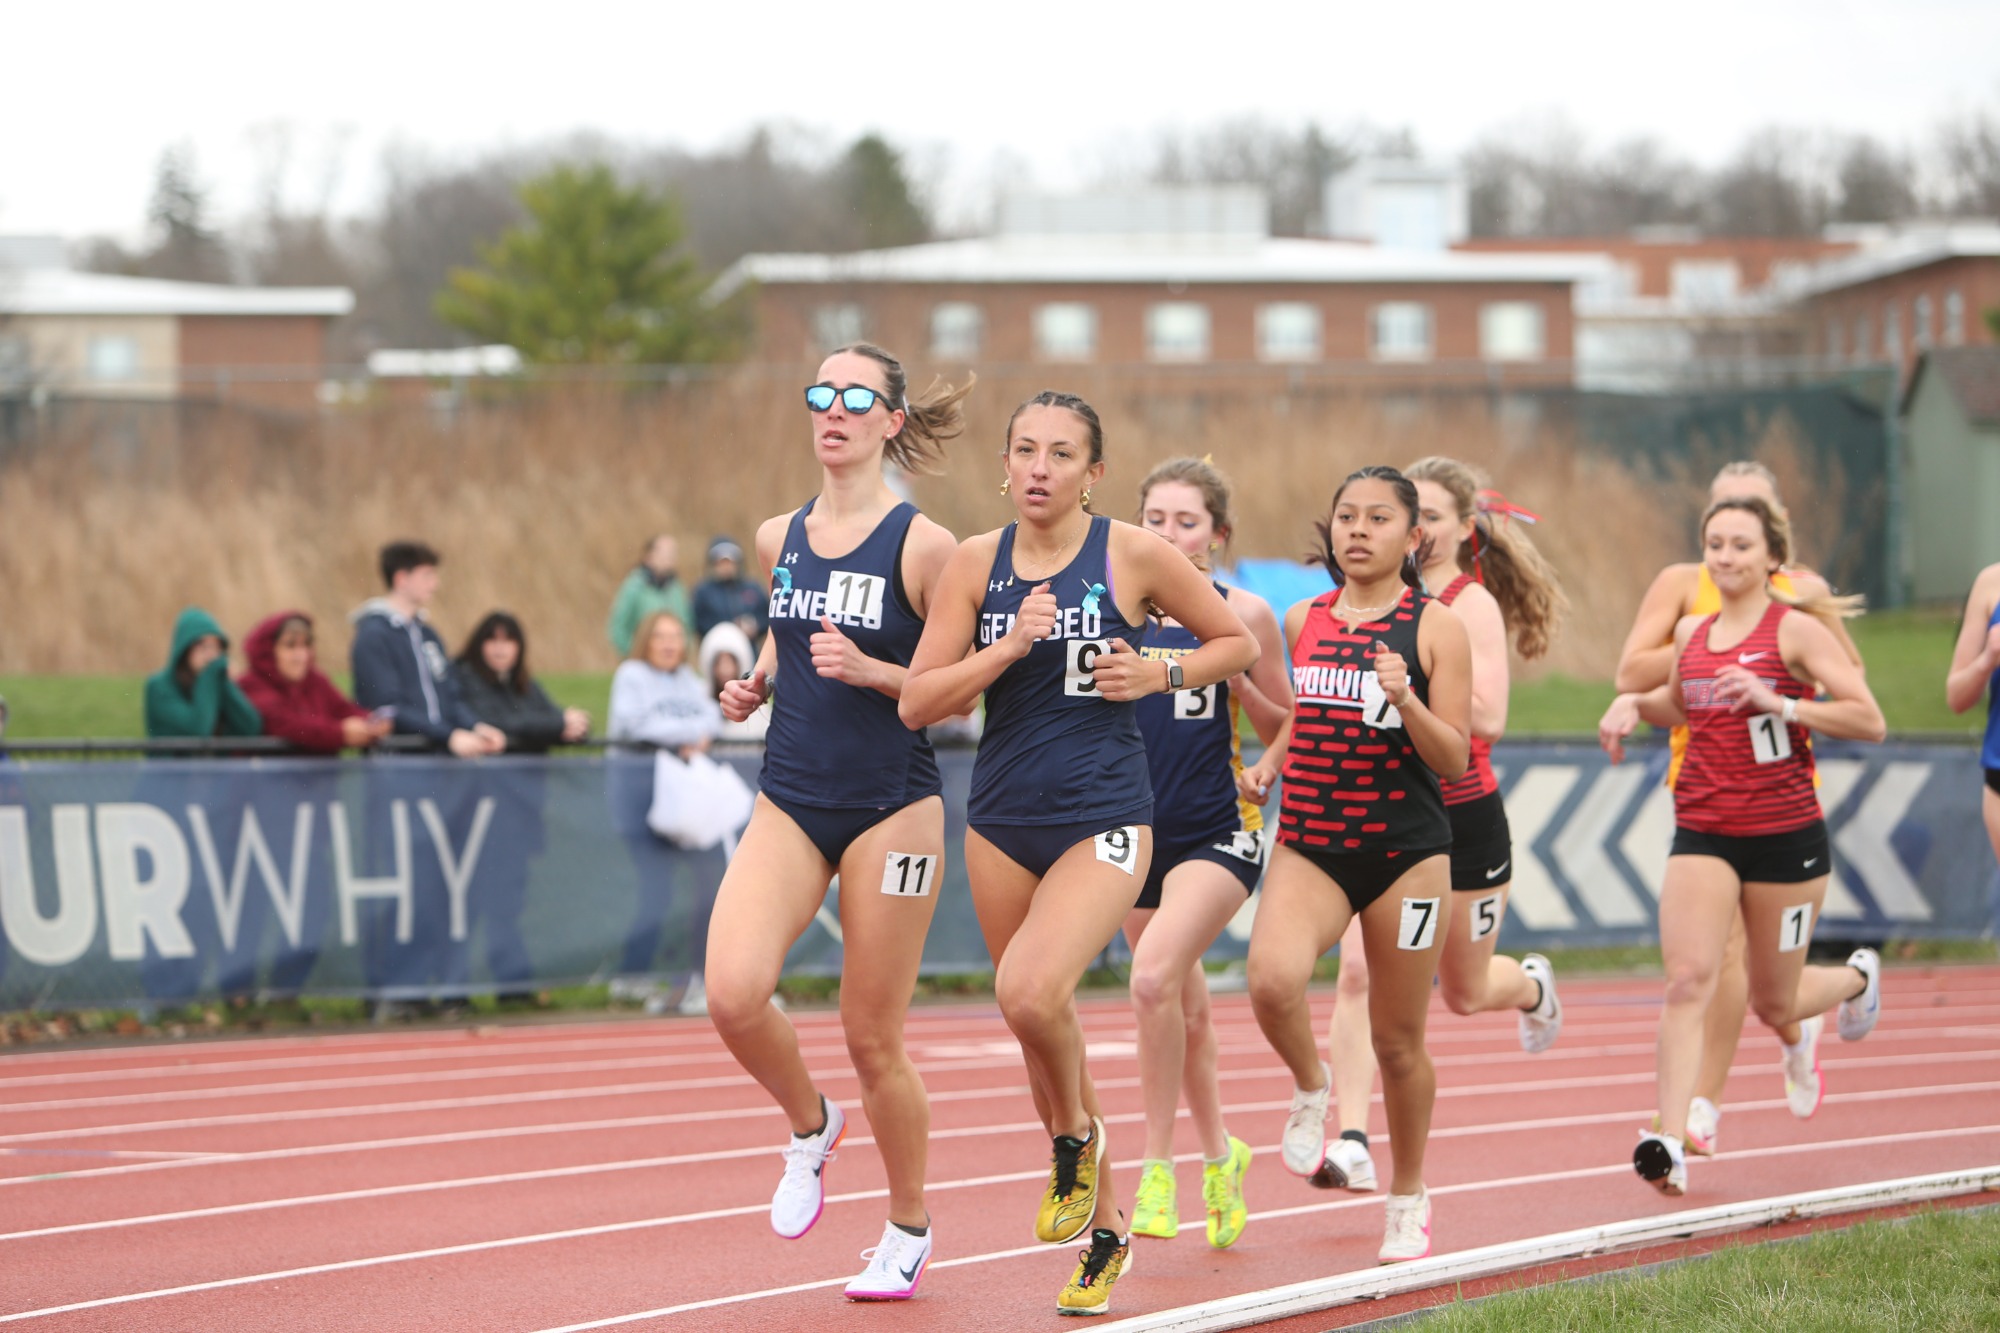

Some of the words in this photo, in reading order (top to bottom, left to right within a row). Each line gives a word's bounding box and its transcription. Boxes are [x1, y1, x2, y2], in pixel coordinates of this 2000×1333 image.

[768, 587, 884, 631] GENE
[839, 575, 873, 615] 11
[980, 607, 1102, 646] GESEO
[1077, 642, 1103, 693] 9
[1760, 717, 1778, 757] 1
[1104, 827, 1131, 864] 9
[896, 856, 928, 893] 11
[1410, 902, 1433, 947] 7
[1479, 899, 1495, 936] 5
[1791, 909, 1803, 946] 1
